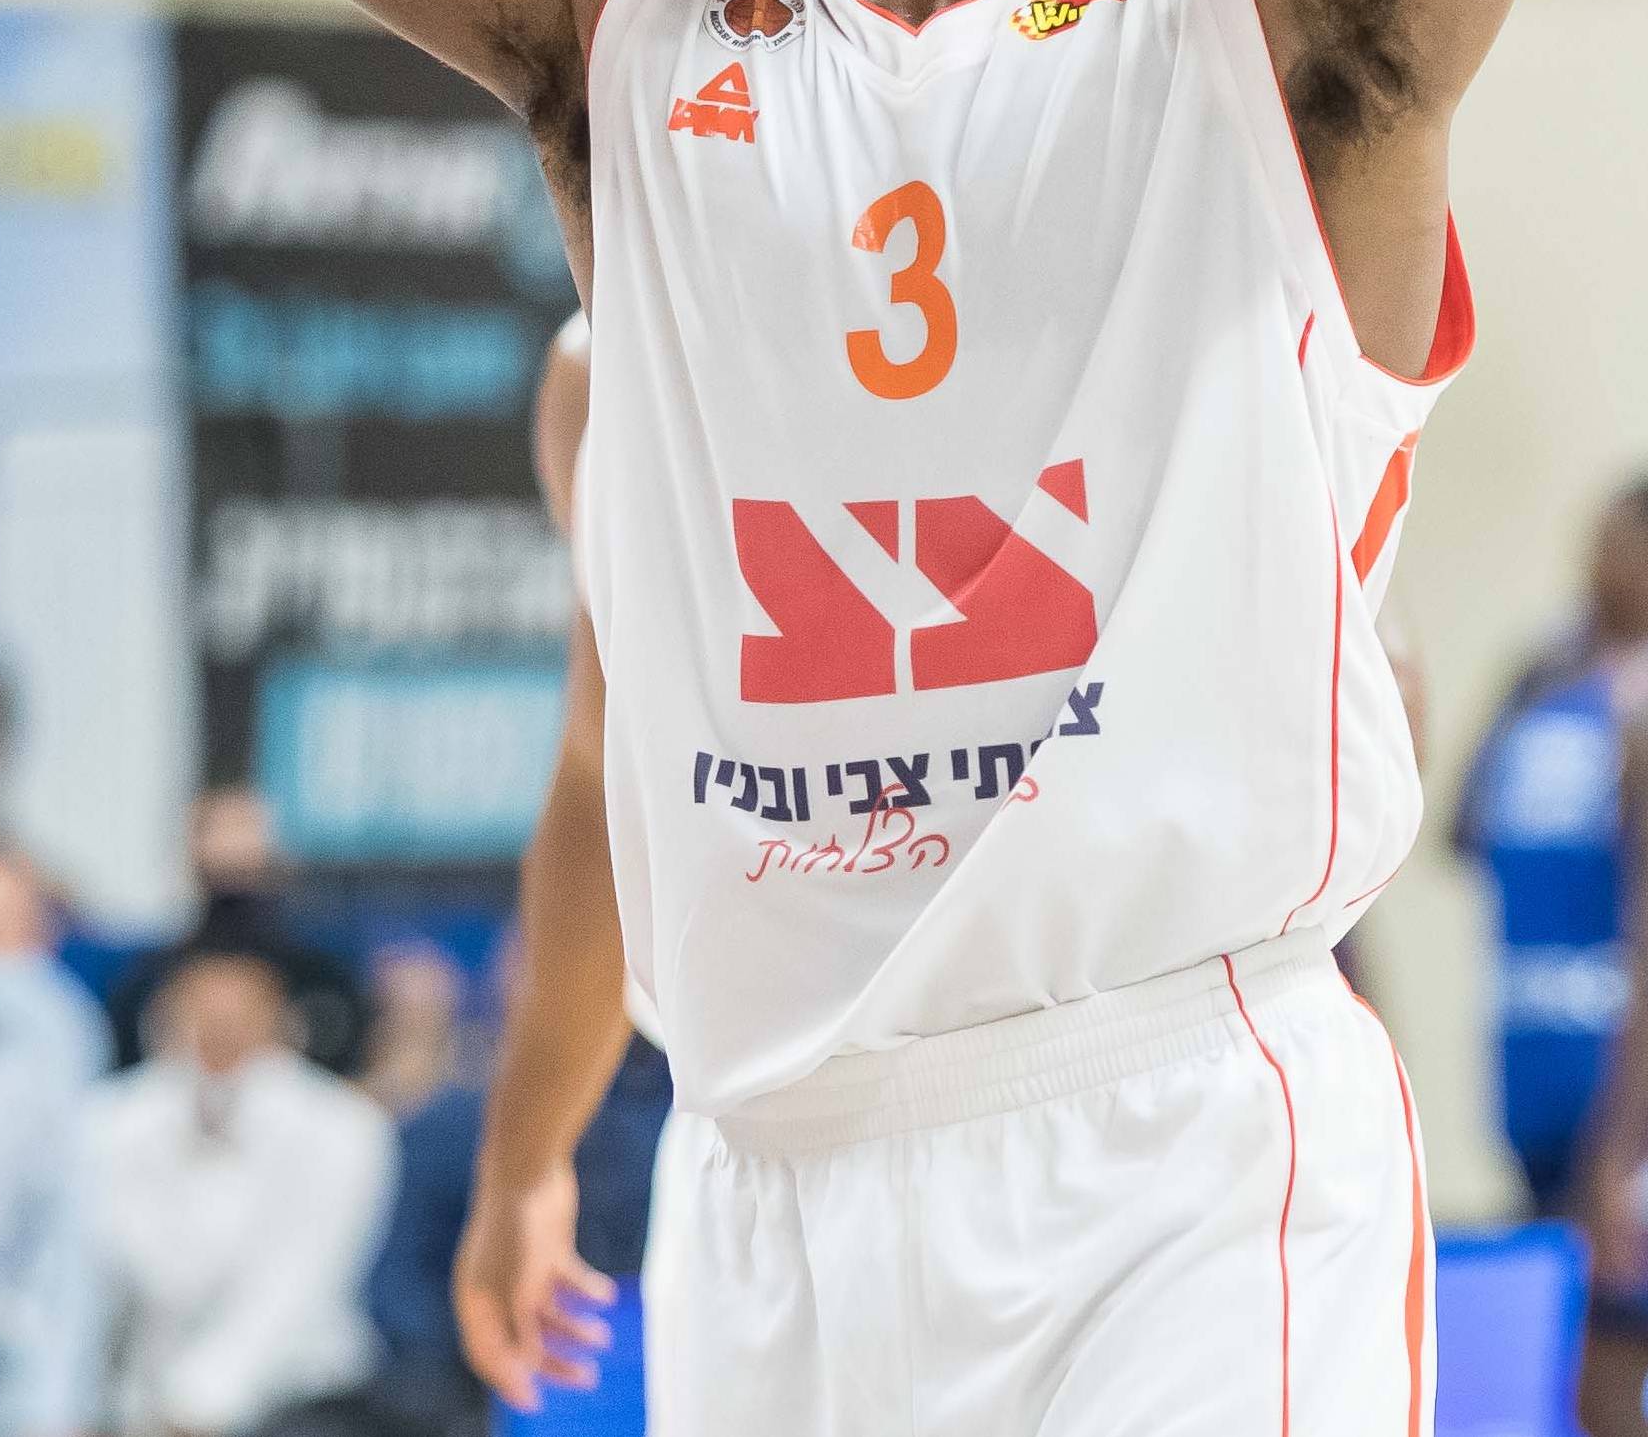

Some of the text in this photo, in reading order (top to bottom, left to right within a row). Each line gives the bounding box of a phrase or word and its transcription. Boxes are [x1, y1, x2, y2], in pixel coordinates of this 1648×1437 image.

[846, 180, 957, 400] 3
[693, 751, 811, 822] ובניו
[826, 752, 932, 816] צבי
[950, 681, 1105, 801] צתי
